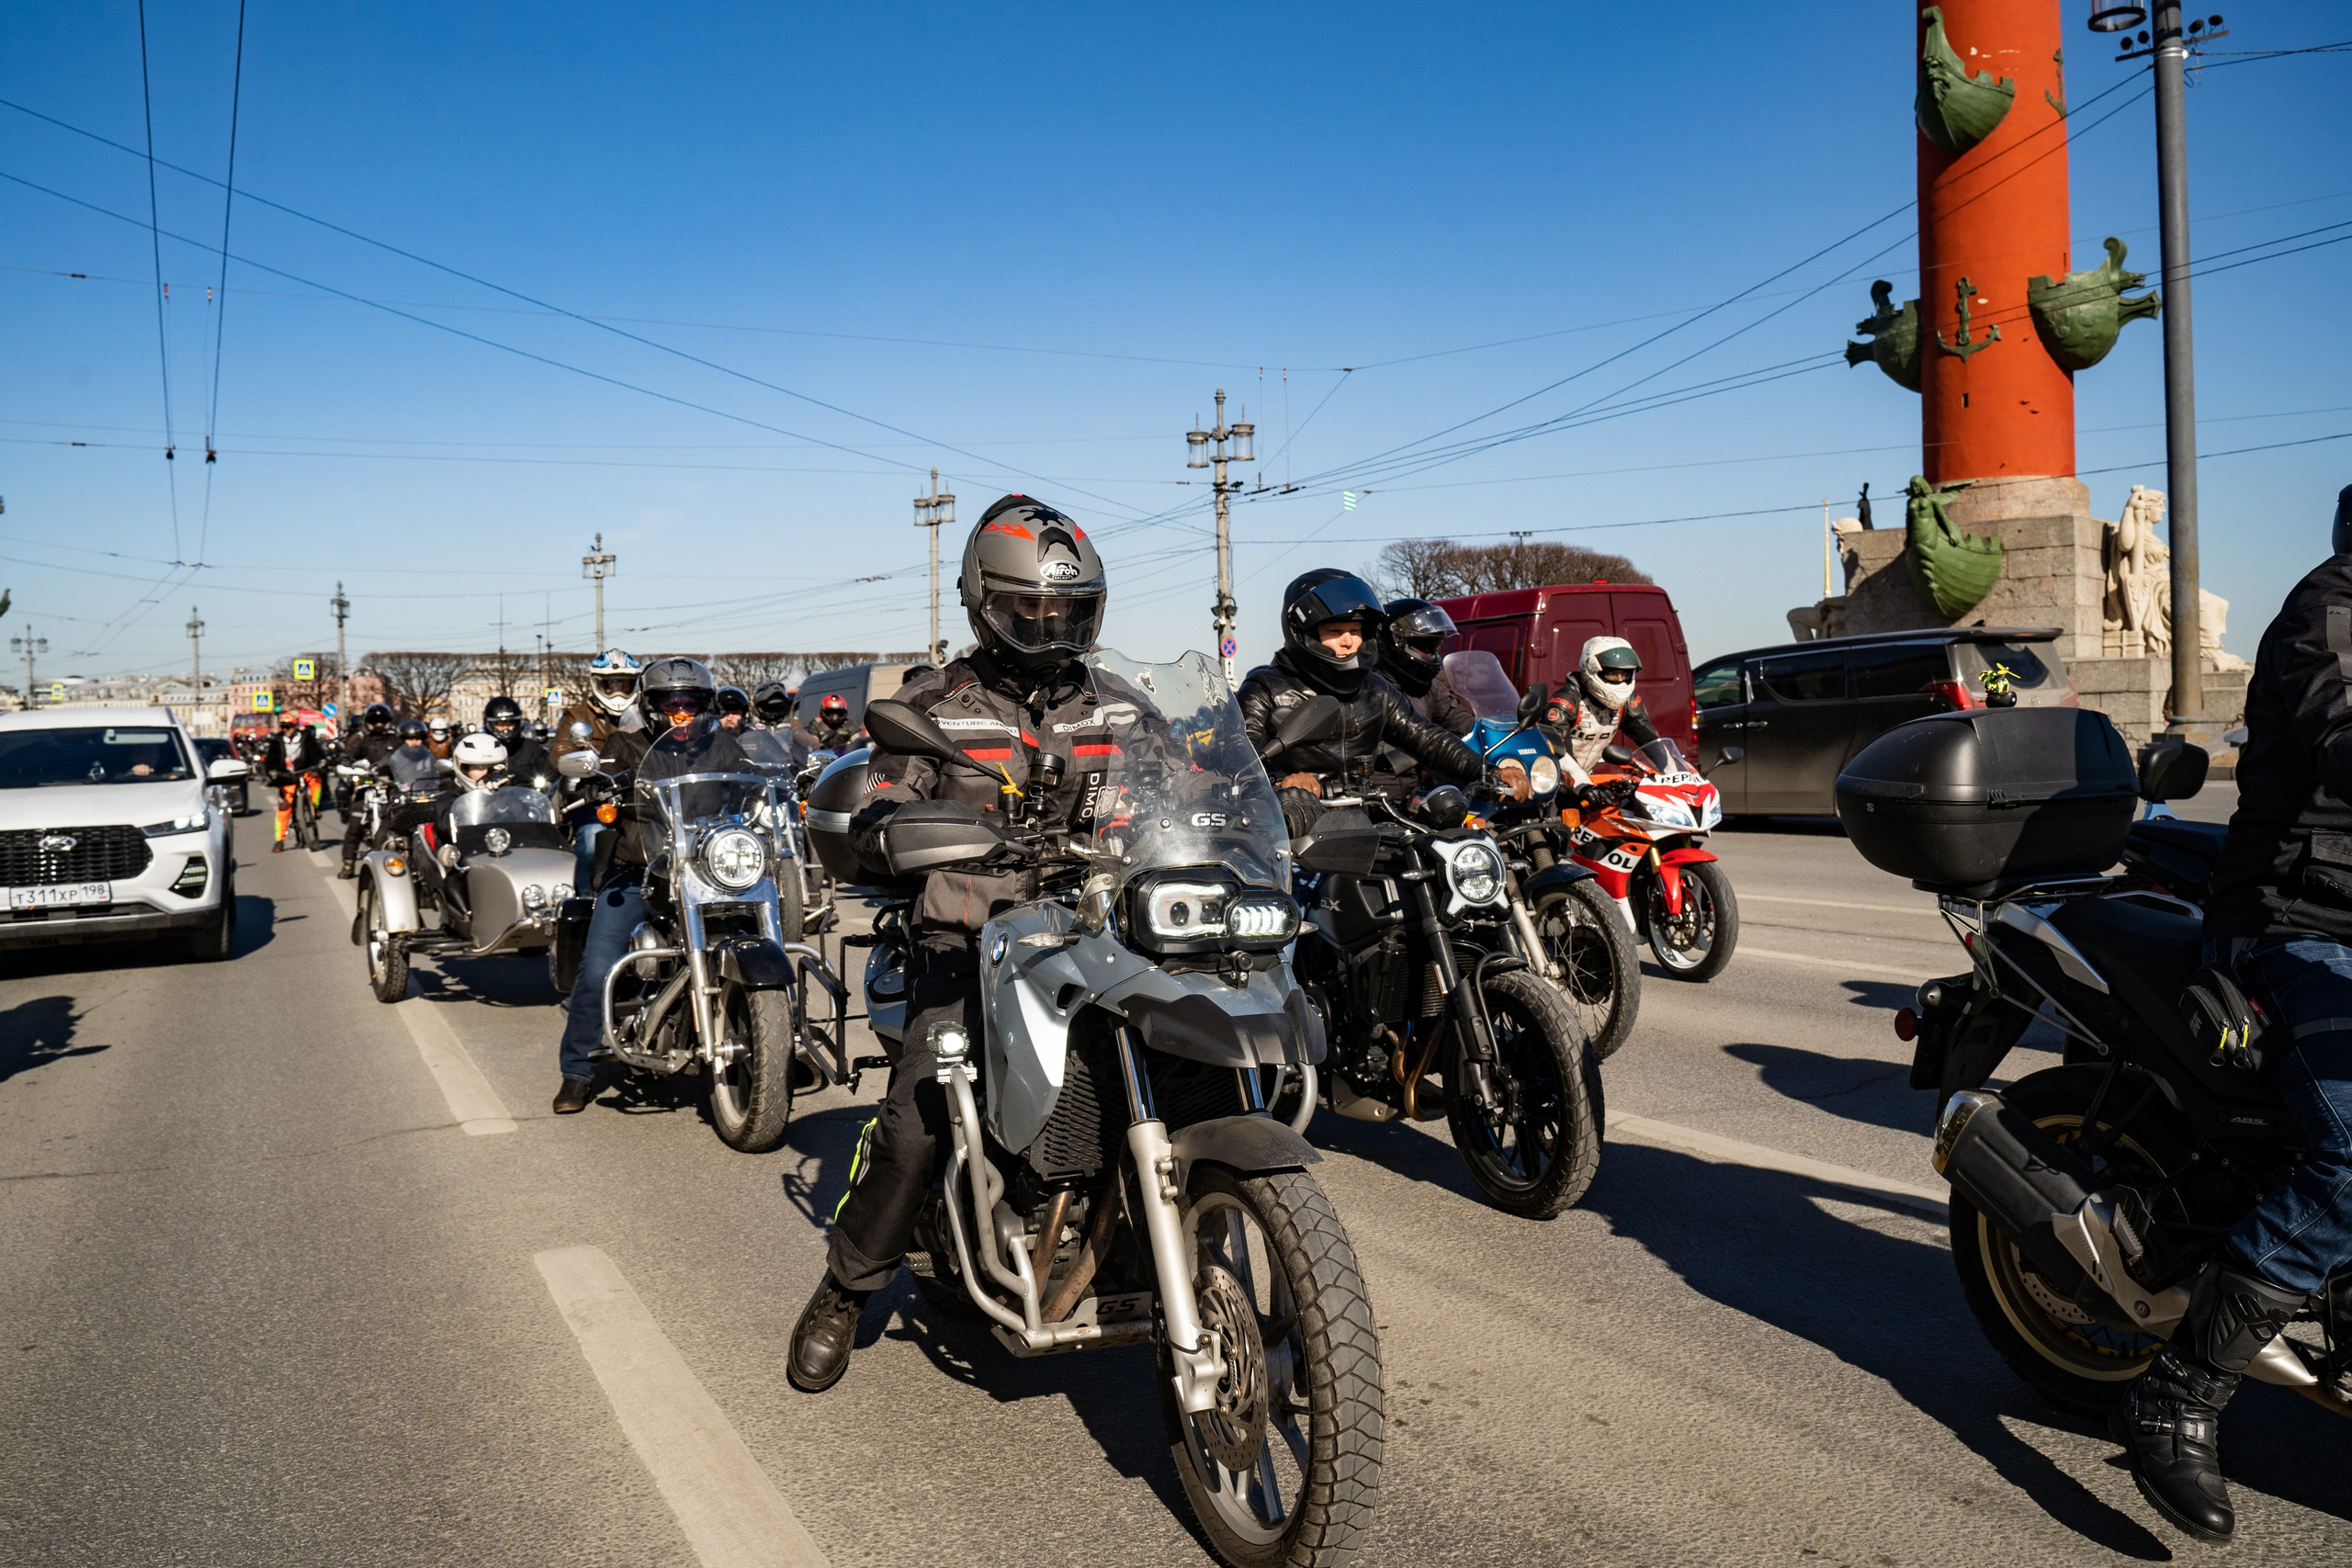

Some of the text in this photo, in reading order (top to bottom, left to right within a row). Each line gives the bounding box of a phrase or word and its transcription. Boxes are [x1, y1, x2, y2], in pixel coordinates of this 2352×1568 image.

[1045, 564, 1079, 576] Airoh
[1062, 717, 1096, 732] DIMOX
[1191, 813, 1227, 827] GS
[82, 885, 106, 897] 198
[1095, 1297, 1141, 1315] GS
